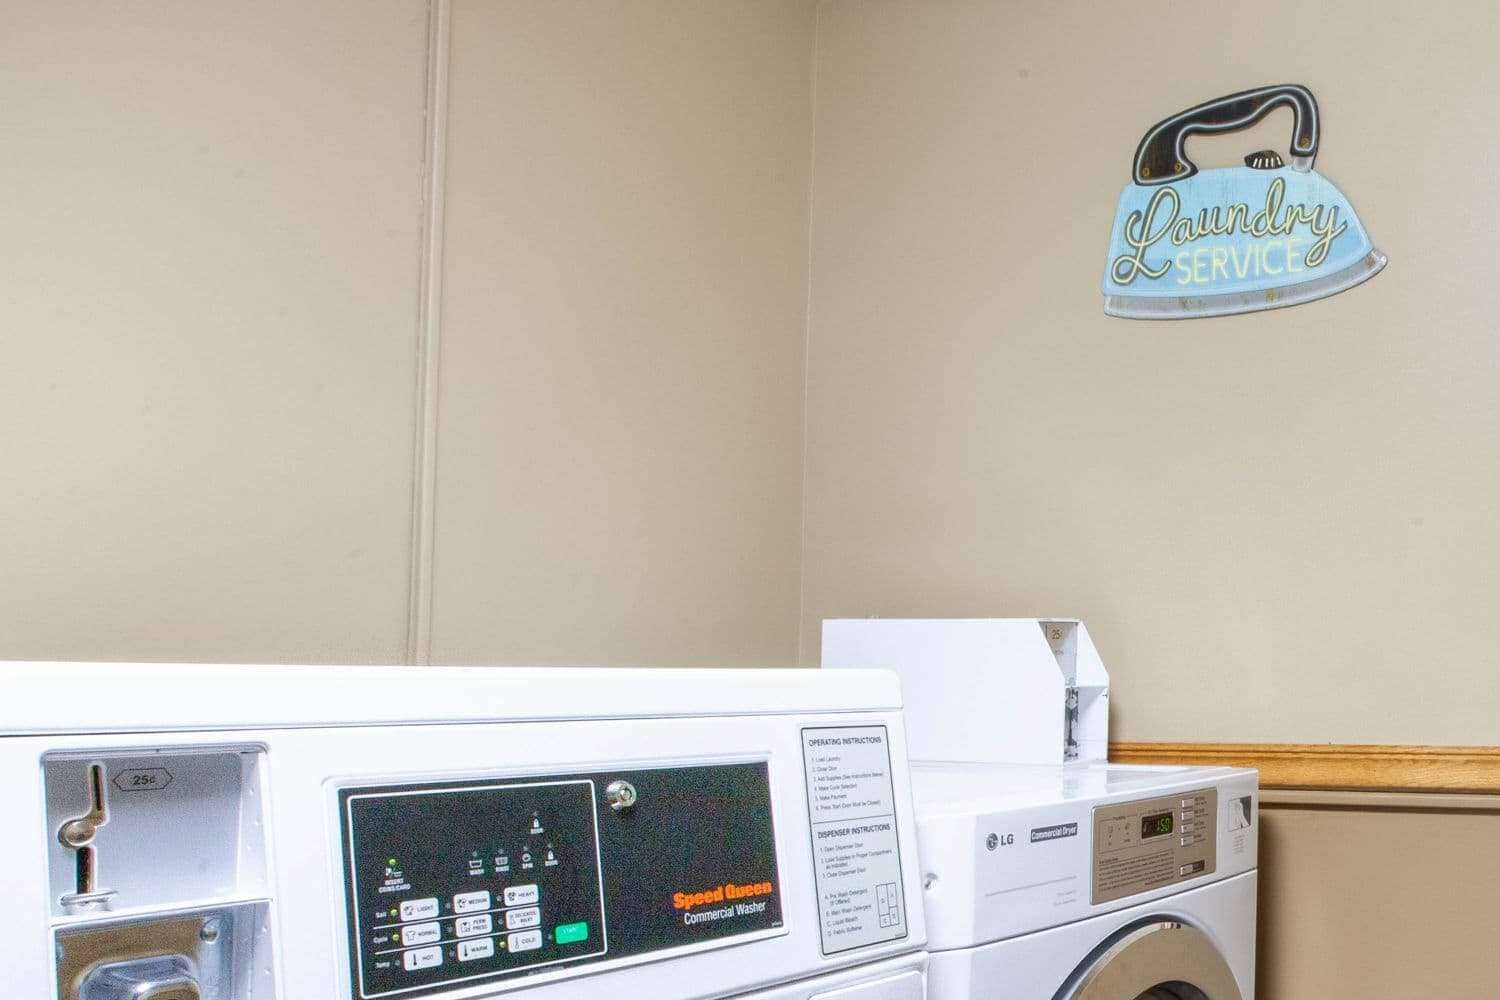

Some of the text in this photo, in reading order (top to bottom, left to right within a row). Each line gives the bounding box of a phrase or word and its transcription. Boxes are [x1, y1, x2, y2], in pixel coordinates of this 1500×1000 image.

[1111, 177, 1347, 285] Laundry
[1175, 238, 1302, 285] SERVICE
[809, 736, 882, 747] OPERATING INSTRUCTIONS
[818, 823, 891, 839] DISPENSER INSTRUCTIONS
[1001, 834, 1014, 846] LG
[1031, 828, 1062, 840] Commercial
[673, 882, 773, 910] Speed Queen
[684, 901, 766, 925] Commercial Washer
